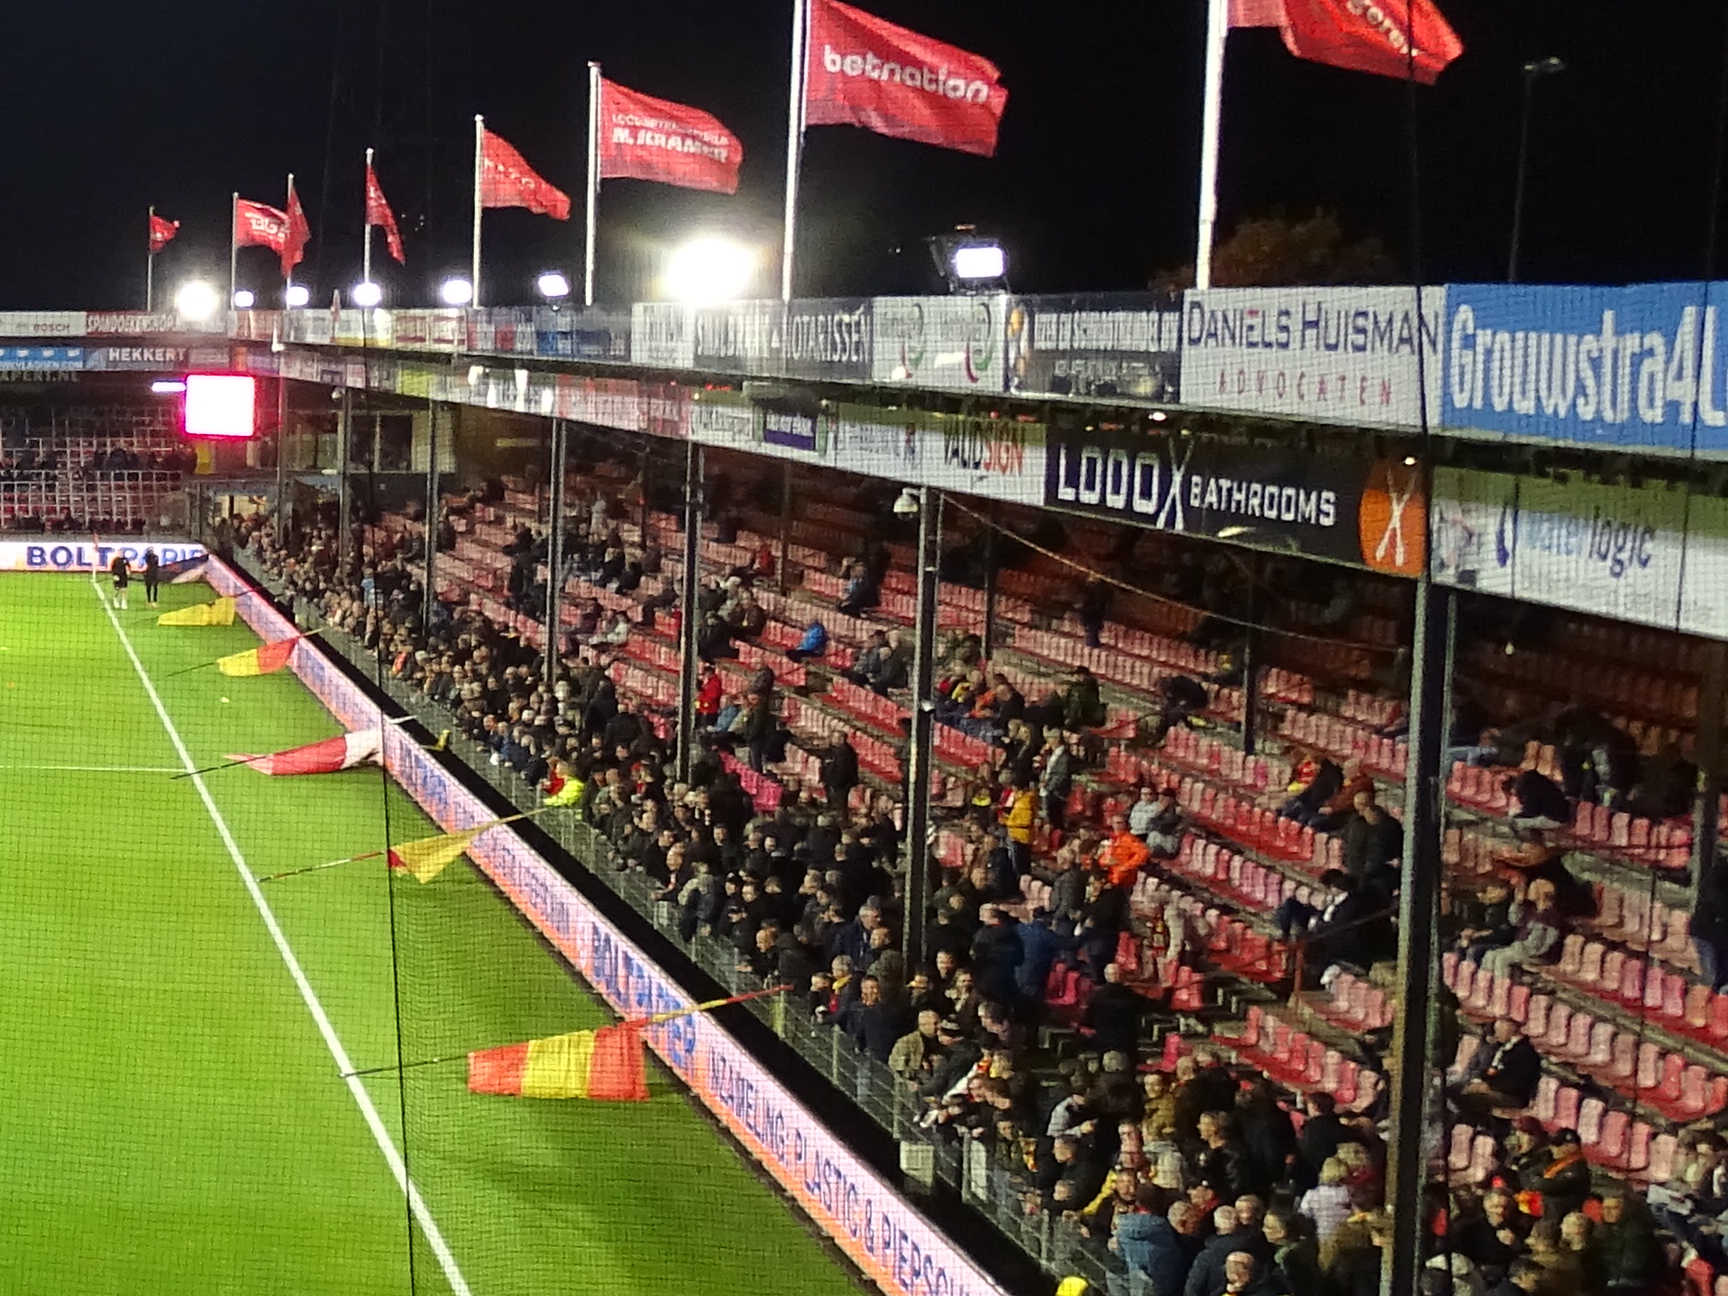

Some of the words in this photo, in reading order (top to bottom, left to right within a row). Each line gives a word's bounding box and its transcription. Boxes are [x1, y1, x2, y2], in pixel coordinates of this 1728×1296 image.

[823, 43, 991, 103] betnation
[33, 322, 71, 332] BOSCH
[1300, 300, 1439, 354] HUISMAN
[108, 348, 187, 362] HEKKERT
[1449, 304, 1728, 428] Grouwstra4L
[1218, 369, 1393, 407] ADVOCATEN
[1189, 474, 1337, 527] BATHROOMS
[795, 1127, 861, 1241] PLASTIC
[864, 1198, 875, 1256] &
